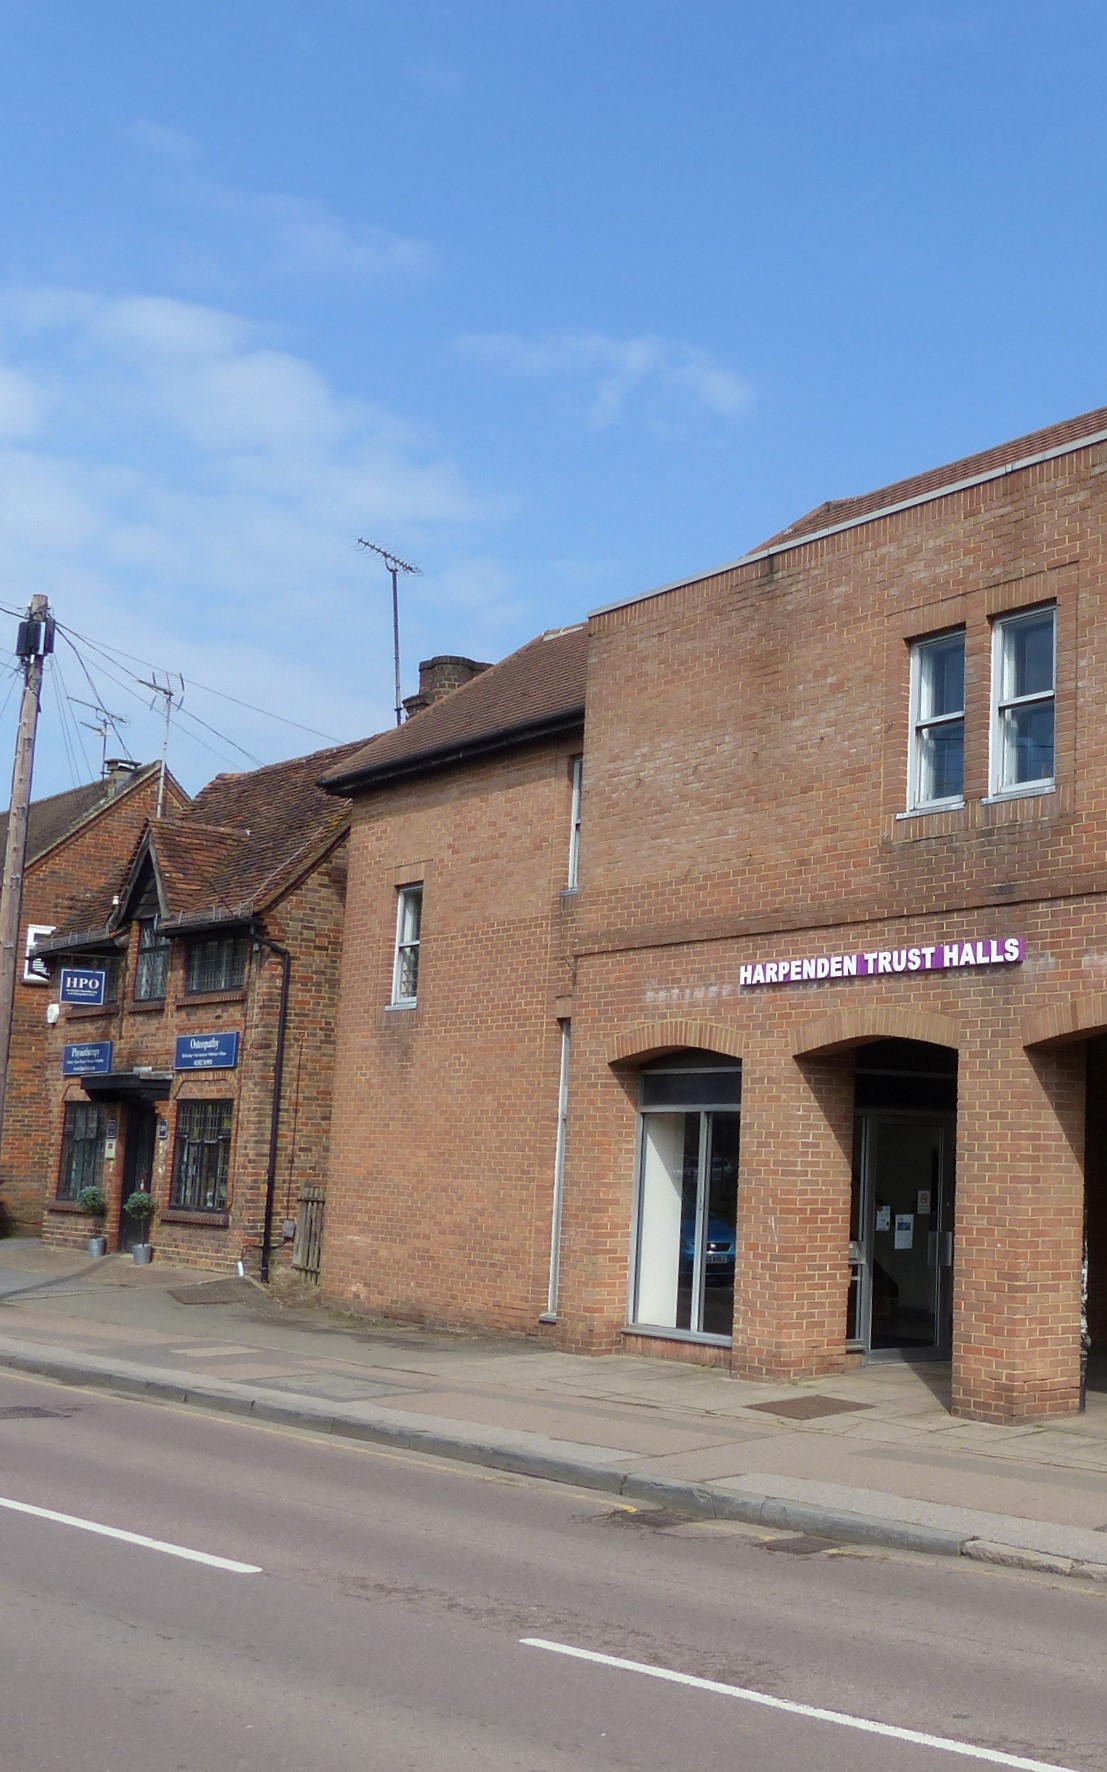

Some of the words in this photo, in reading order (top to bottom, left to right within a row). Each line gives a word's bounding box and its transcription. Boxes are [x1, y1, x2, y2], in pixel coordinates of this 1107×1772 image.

[740, 955, 857, 985] HARPENDEN
[864, 947, 935, 973] TRUST
[942, 938, 1020, 967] HALLS
[66, 977, 100, 990] HPO
[190, 1037, 219, 1050] Osteopathy
